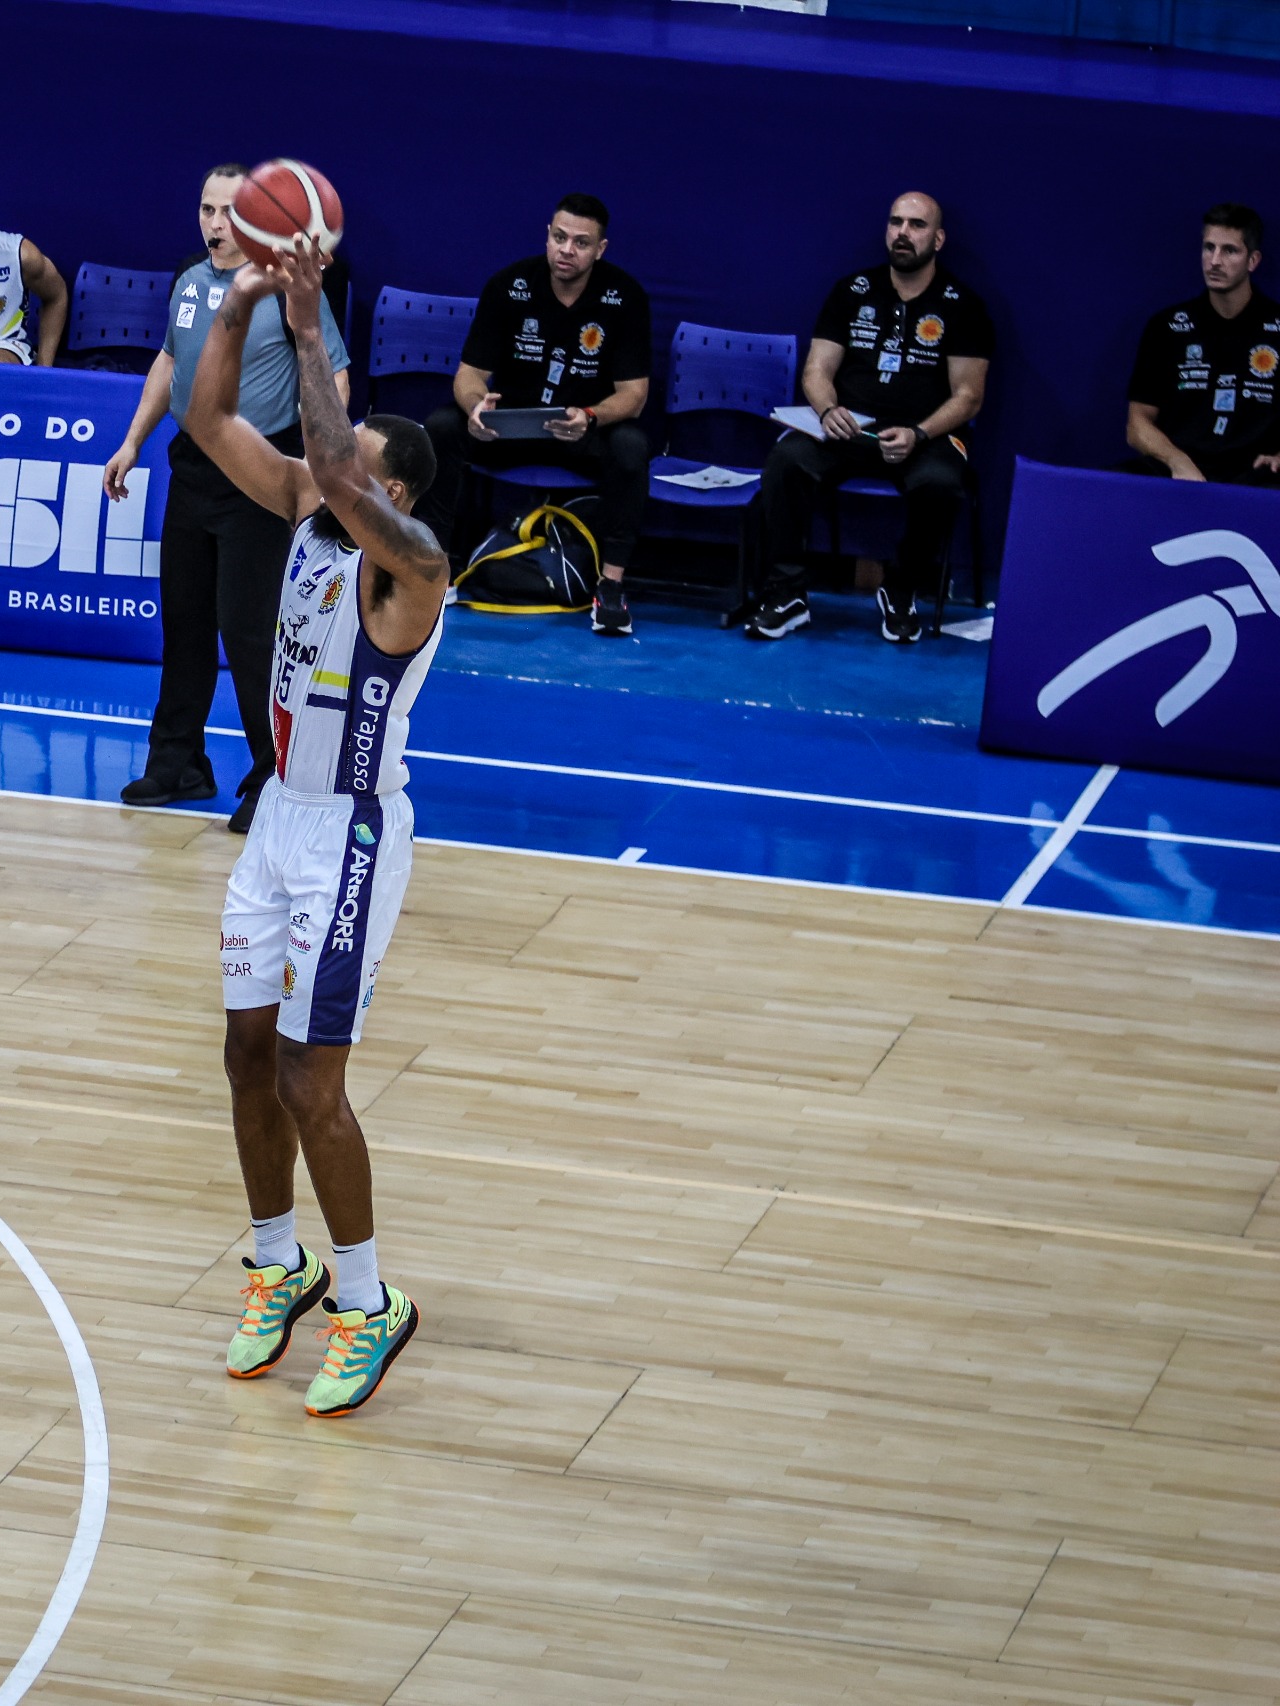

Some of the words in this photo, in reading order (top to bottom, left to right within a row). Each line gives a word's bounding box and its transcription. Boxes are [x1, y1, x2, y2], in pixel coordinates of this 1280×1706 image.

[45, 416, 96, 442] DO
[8, 590, 158, 618] BRASILEIRO
[353, 709, 380, 791] raposo
[224, 933, 249, 947] sabin
